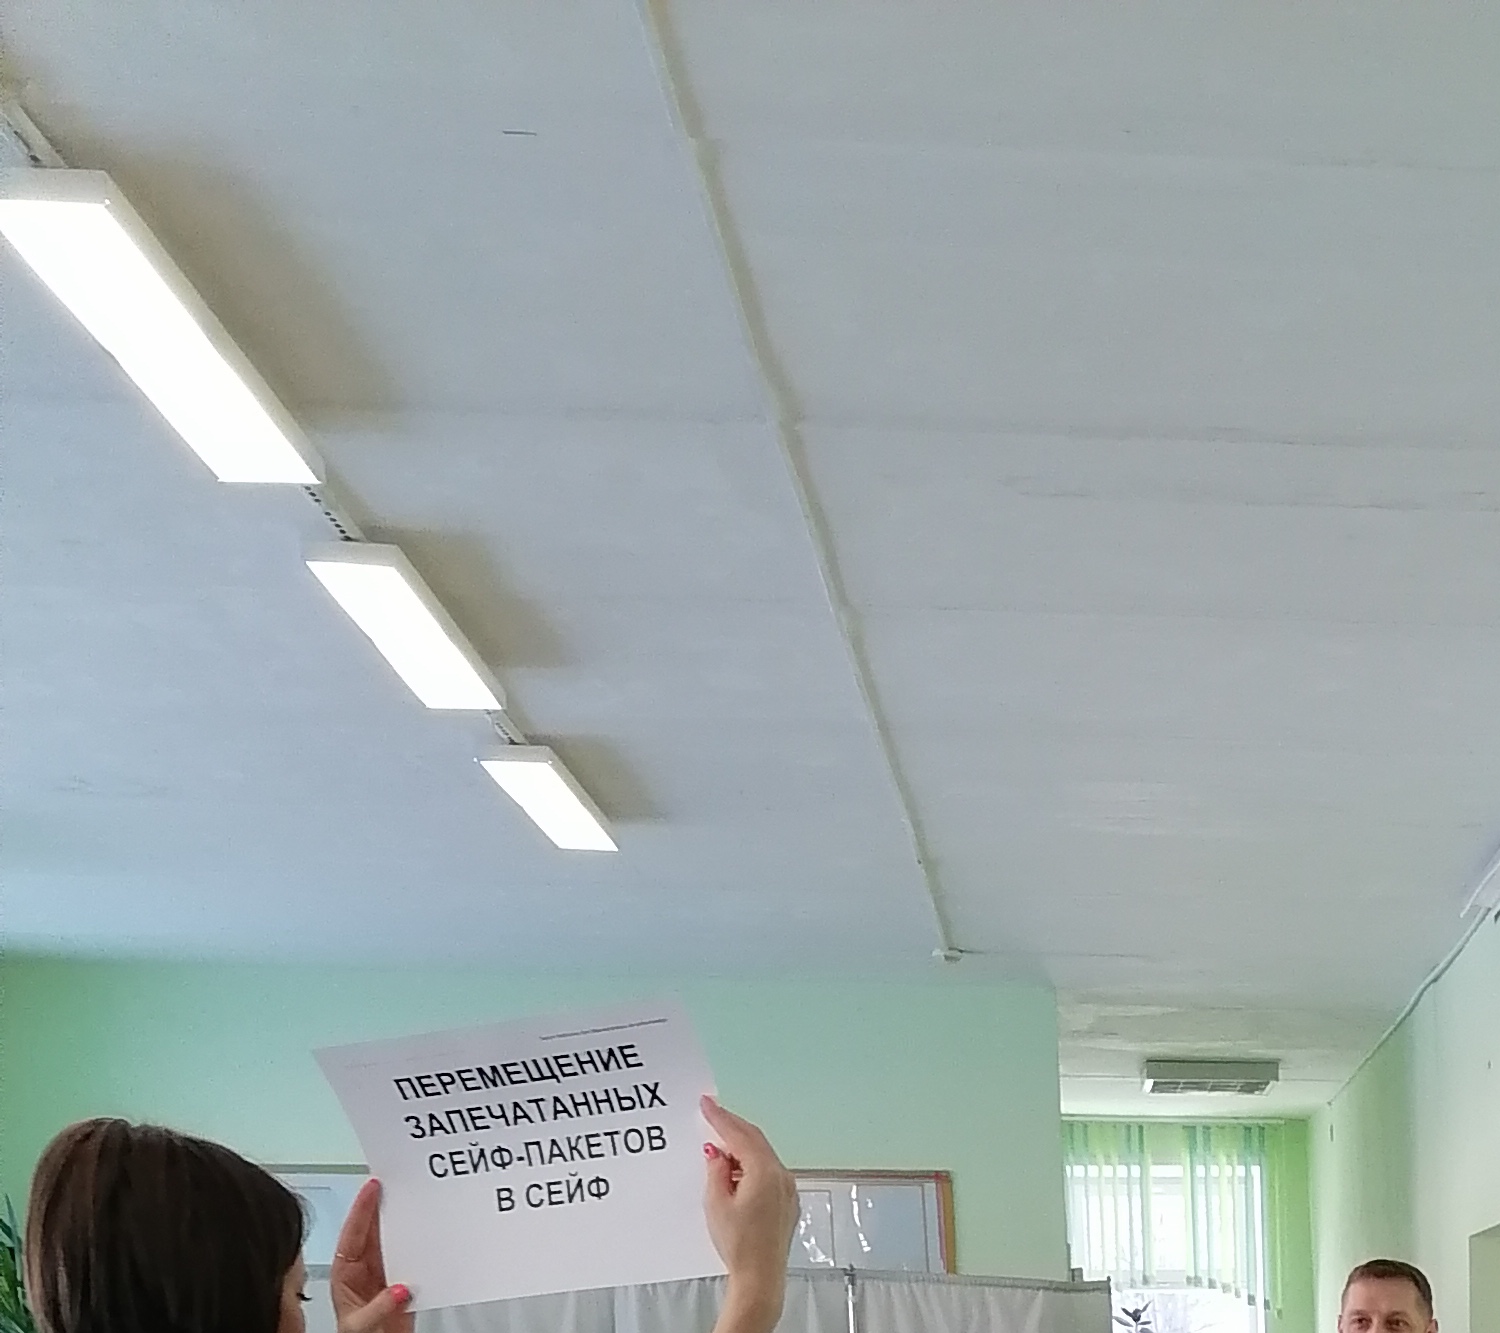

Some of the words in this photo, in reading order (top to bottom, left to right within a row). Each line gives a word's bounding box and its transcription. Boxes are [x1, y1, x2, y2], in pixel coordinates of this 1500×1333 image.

[393, 1044, 644, 1101] ПЕРЕМЕЩЕНИЕ
[404, 1082, 668, 1140] ЗАПЕЧАТАННЫХ
[429, 1125, 667, 1179] СЕЙФ-ПАКЕТОВ
[496, 1187, 515, 1212] В
[525, 1172, 610, 1208] СЕЙФ
